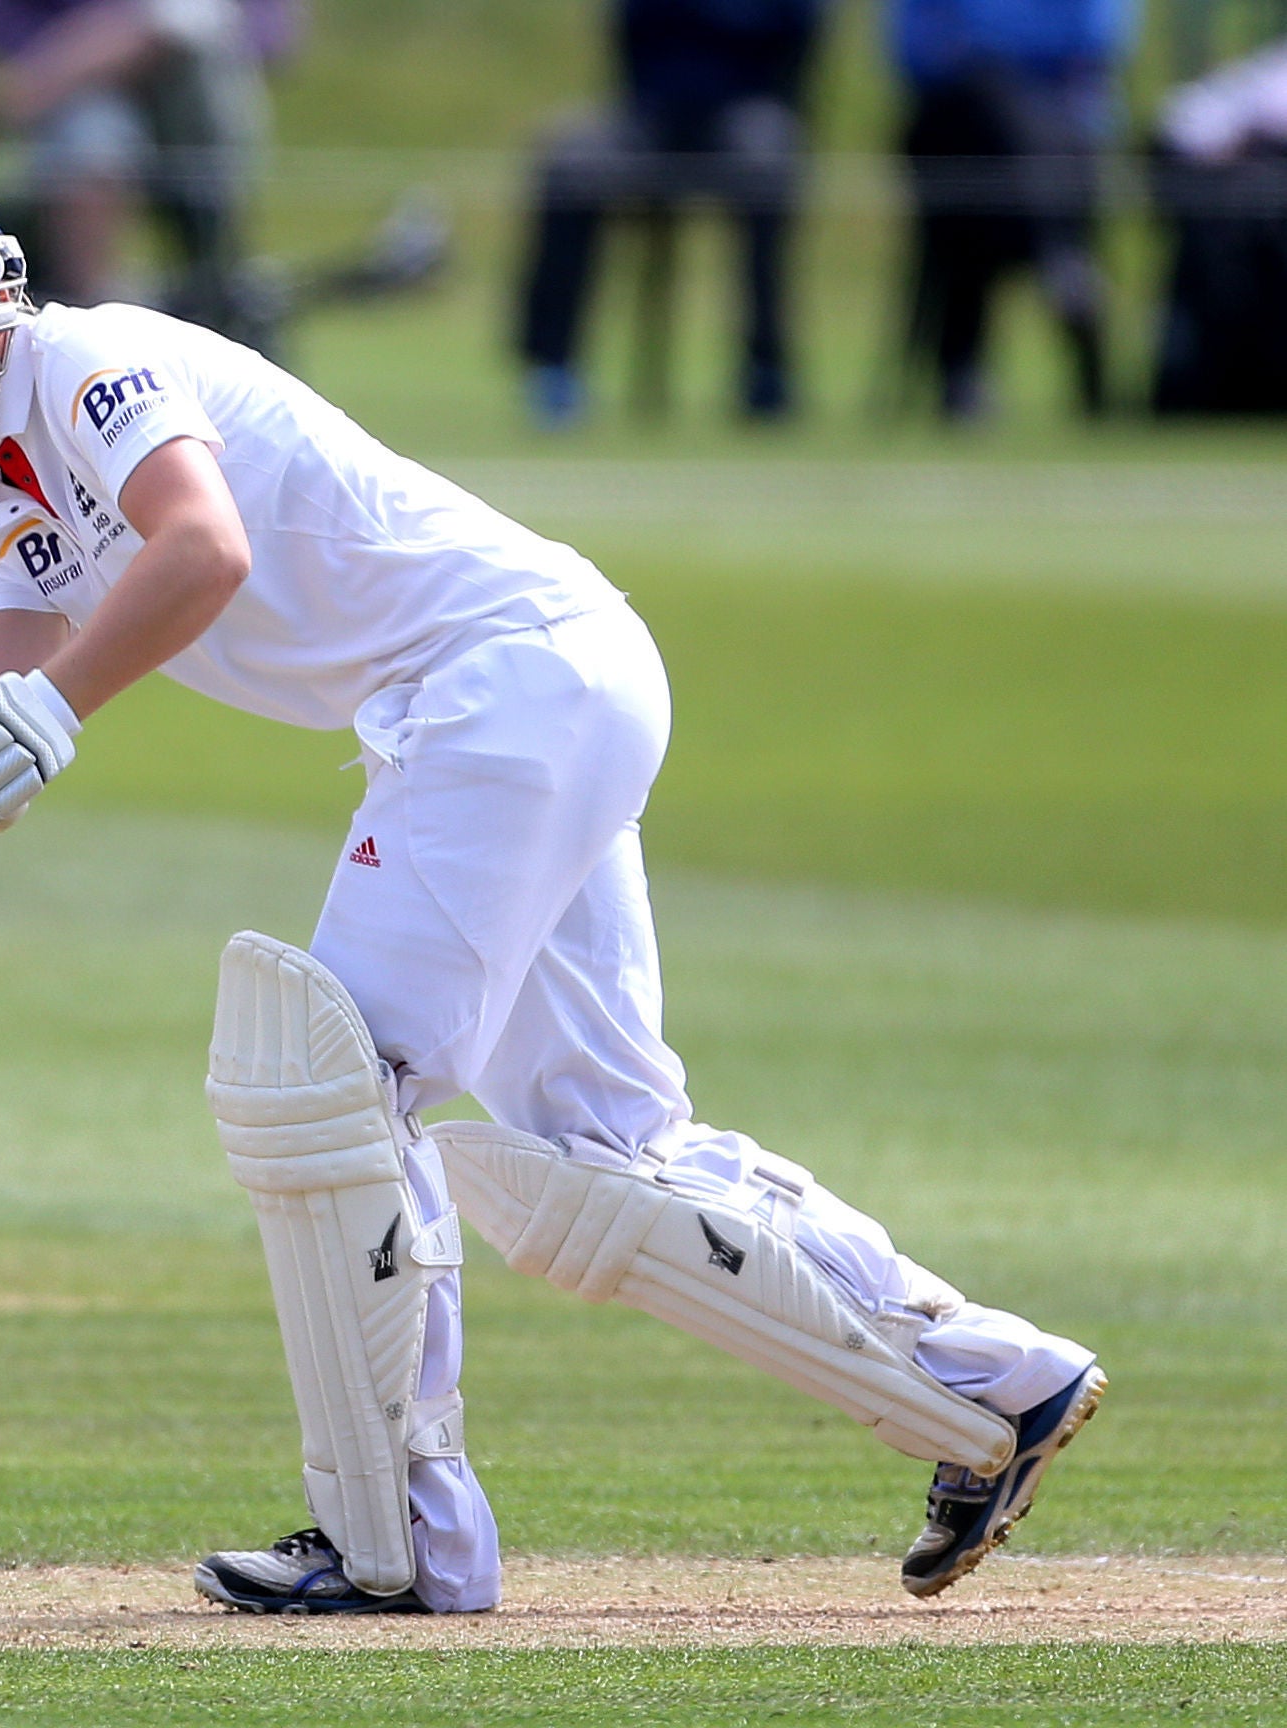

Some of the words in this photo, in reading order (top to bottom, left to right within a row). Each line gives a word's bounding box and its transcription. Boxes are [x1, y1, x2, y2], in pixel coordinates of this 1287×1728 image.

[83, 367, 165, 432] Brit
[93, 512, 111, 534] 149
[16, 532, 61, 578] Br
[350, 852, 381, 868] adidas
